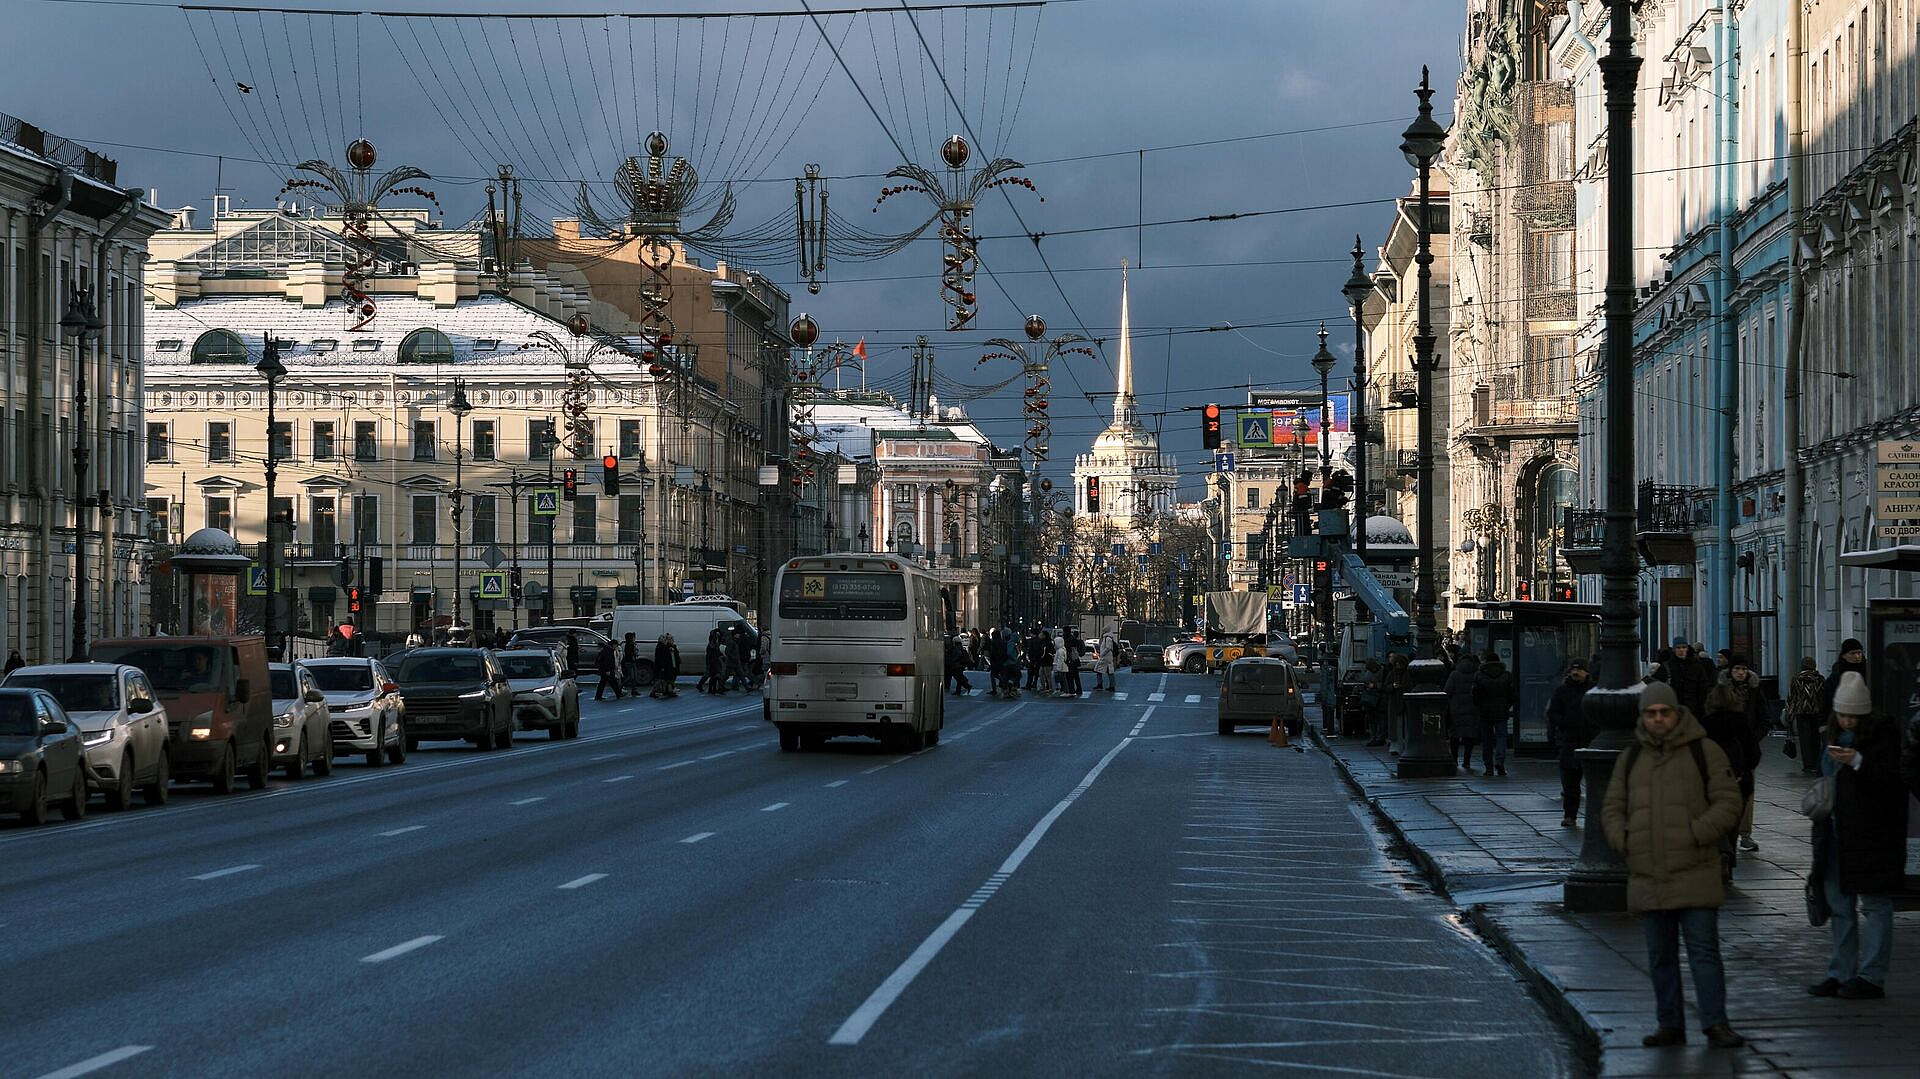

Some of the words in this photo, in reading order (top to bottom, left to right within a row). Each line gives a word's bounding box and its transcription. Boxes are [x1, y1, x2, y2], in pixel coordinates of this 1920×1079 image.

[1889, 472, 1920, 480] САЛОН
[1884, 527, 1896, 535] ВО
[1898, 527, 1920, 536] ДВОР
